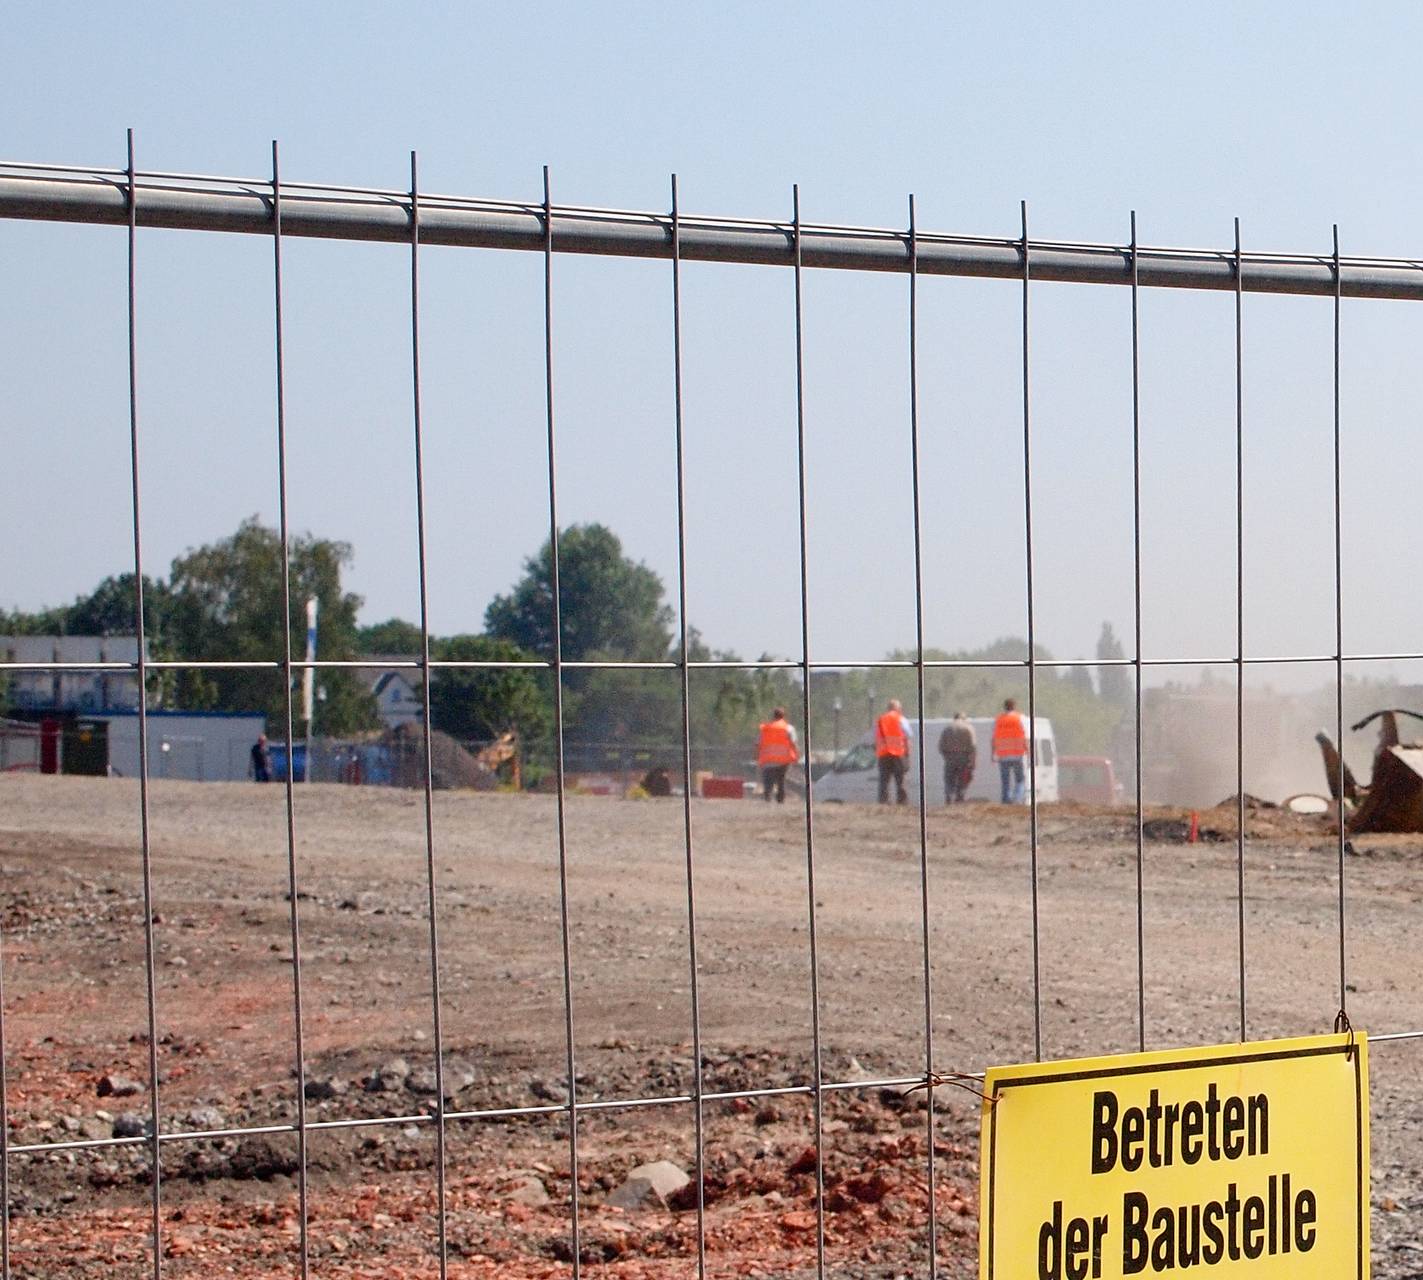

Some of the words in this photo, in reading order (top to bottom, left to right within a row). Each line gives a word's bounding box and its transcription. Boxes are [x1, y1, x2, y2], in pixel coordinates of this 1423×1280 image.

[1091, 1083, 1269, 1174] Betreten
[1038, 1201, 1108, 1280] der
[1123, 1173, 1316, 1274] Baustelle
